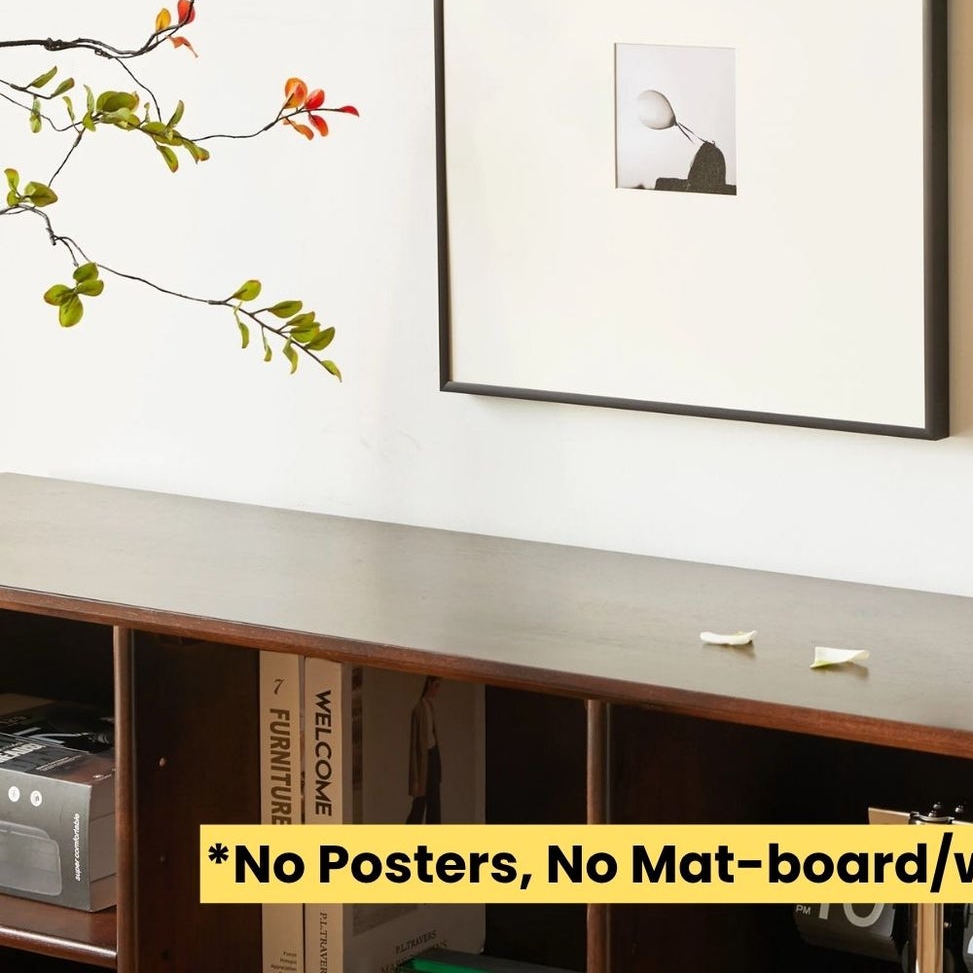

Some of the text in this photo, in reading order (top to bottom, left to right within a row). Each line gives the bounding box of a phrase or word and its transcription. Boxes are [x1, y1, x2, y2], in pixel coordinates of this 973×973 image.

[273, 678, 284, 695] 7
[269, 708, 292, 825] FURNITURE
[315, 689, 332, 817] WELCOME
[795, 904, 811, 916] PM
